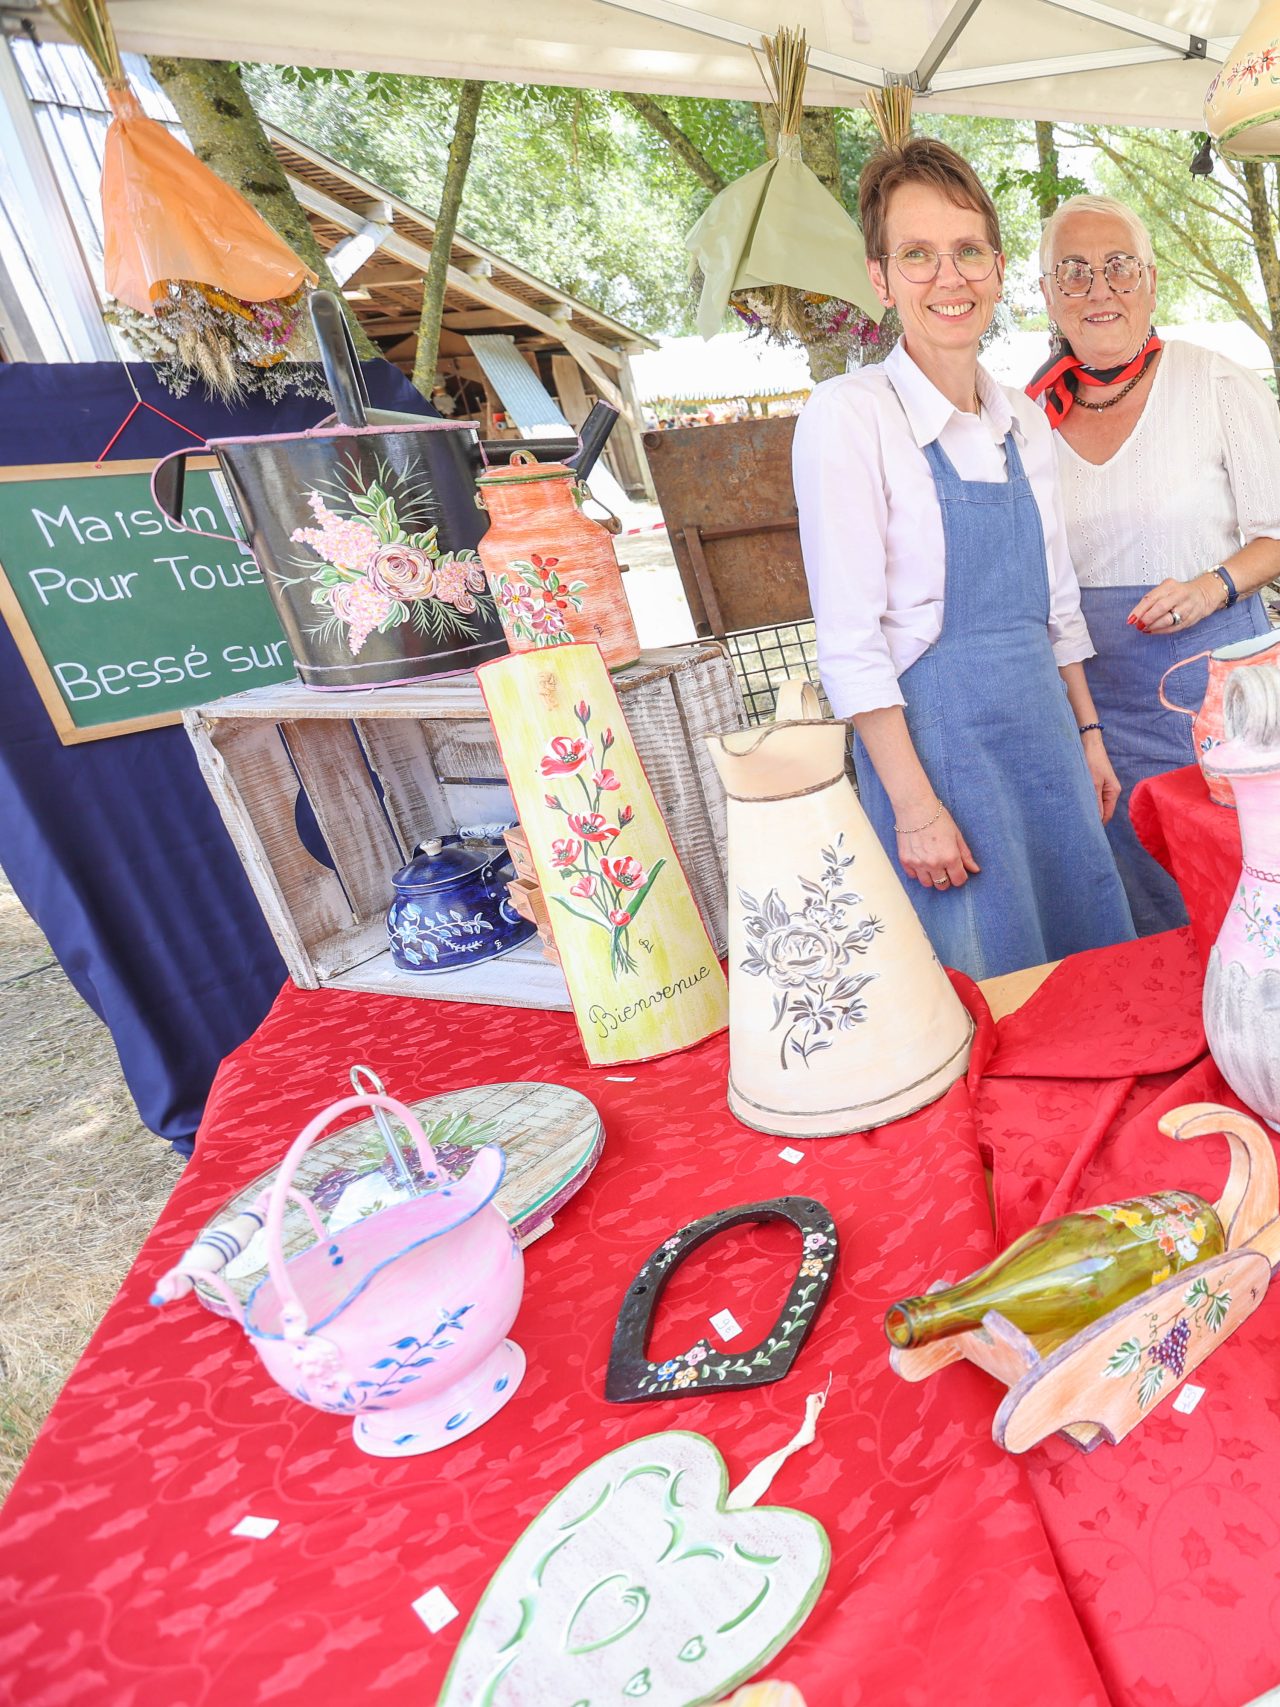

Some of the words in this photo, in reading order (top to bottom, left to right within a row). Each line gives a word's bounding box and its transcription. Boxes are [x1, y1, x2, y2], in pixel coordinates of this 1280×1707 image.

[28, 567, 139, 606] Pour
[153, 555, 265, 591] Tous
[53, 644, 212, 701] Bessé
[222, 640, 288, 673] sur
[588, 965, 711, 1039] Bienvenue
